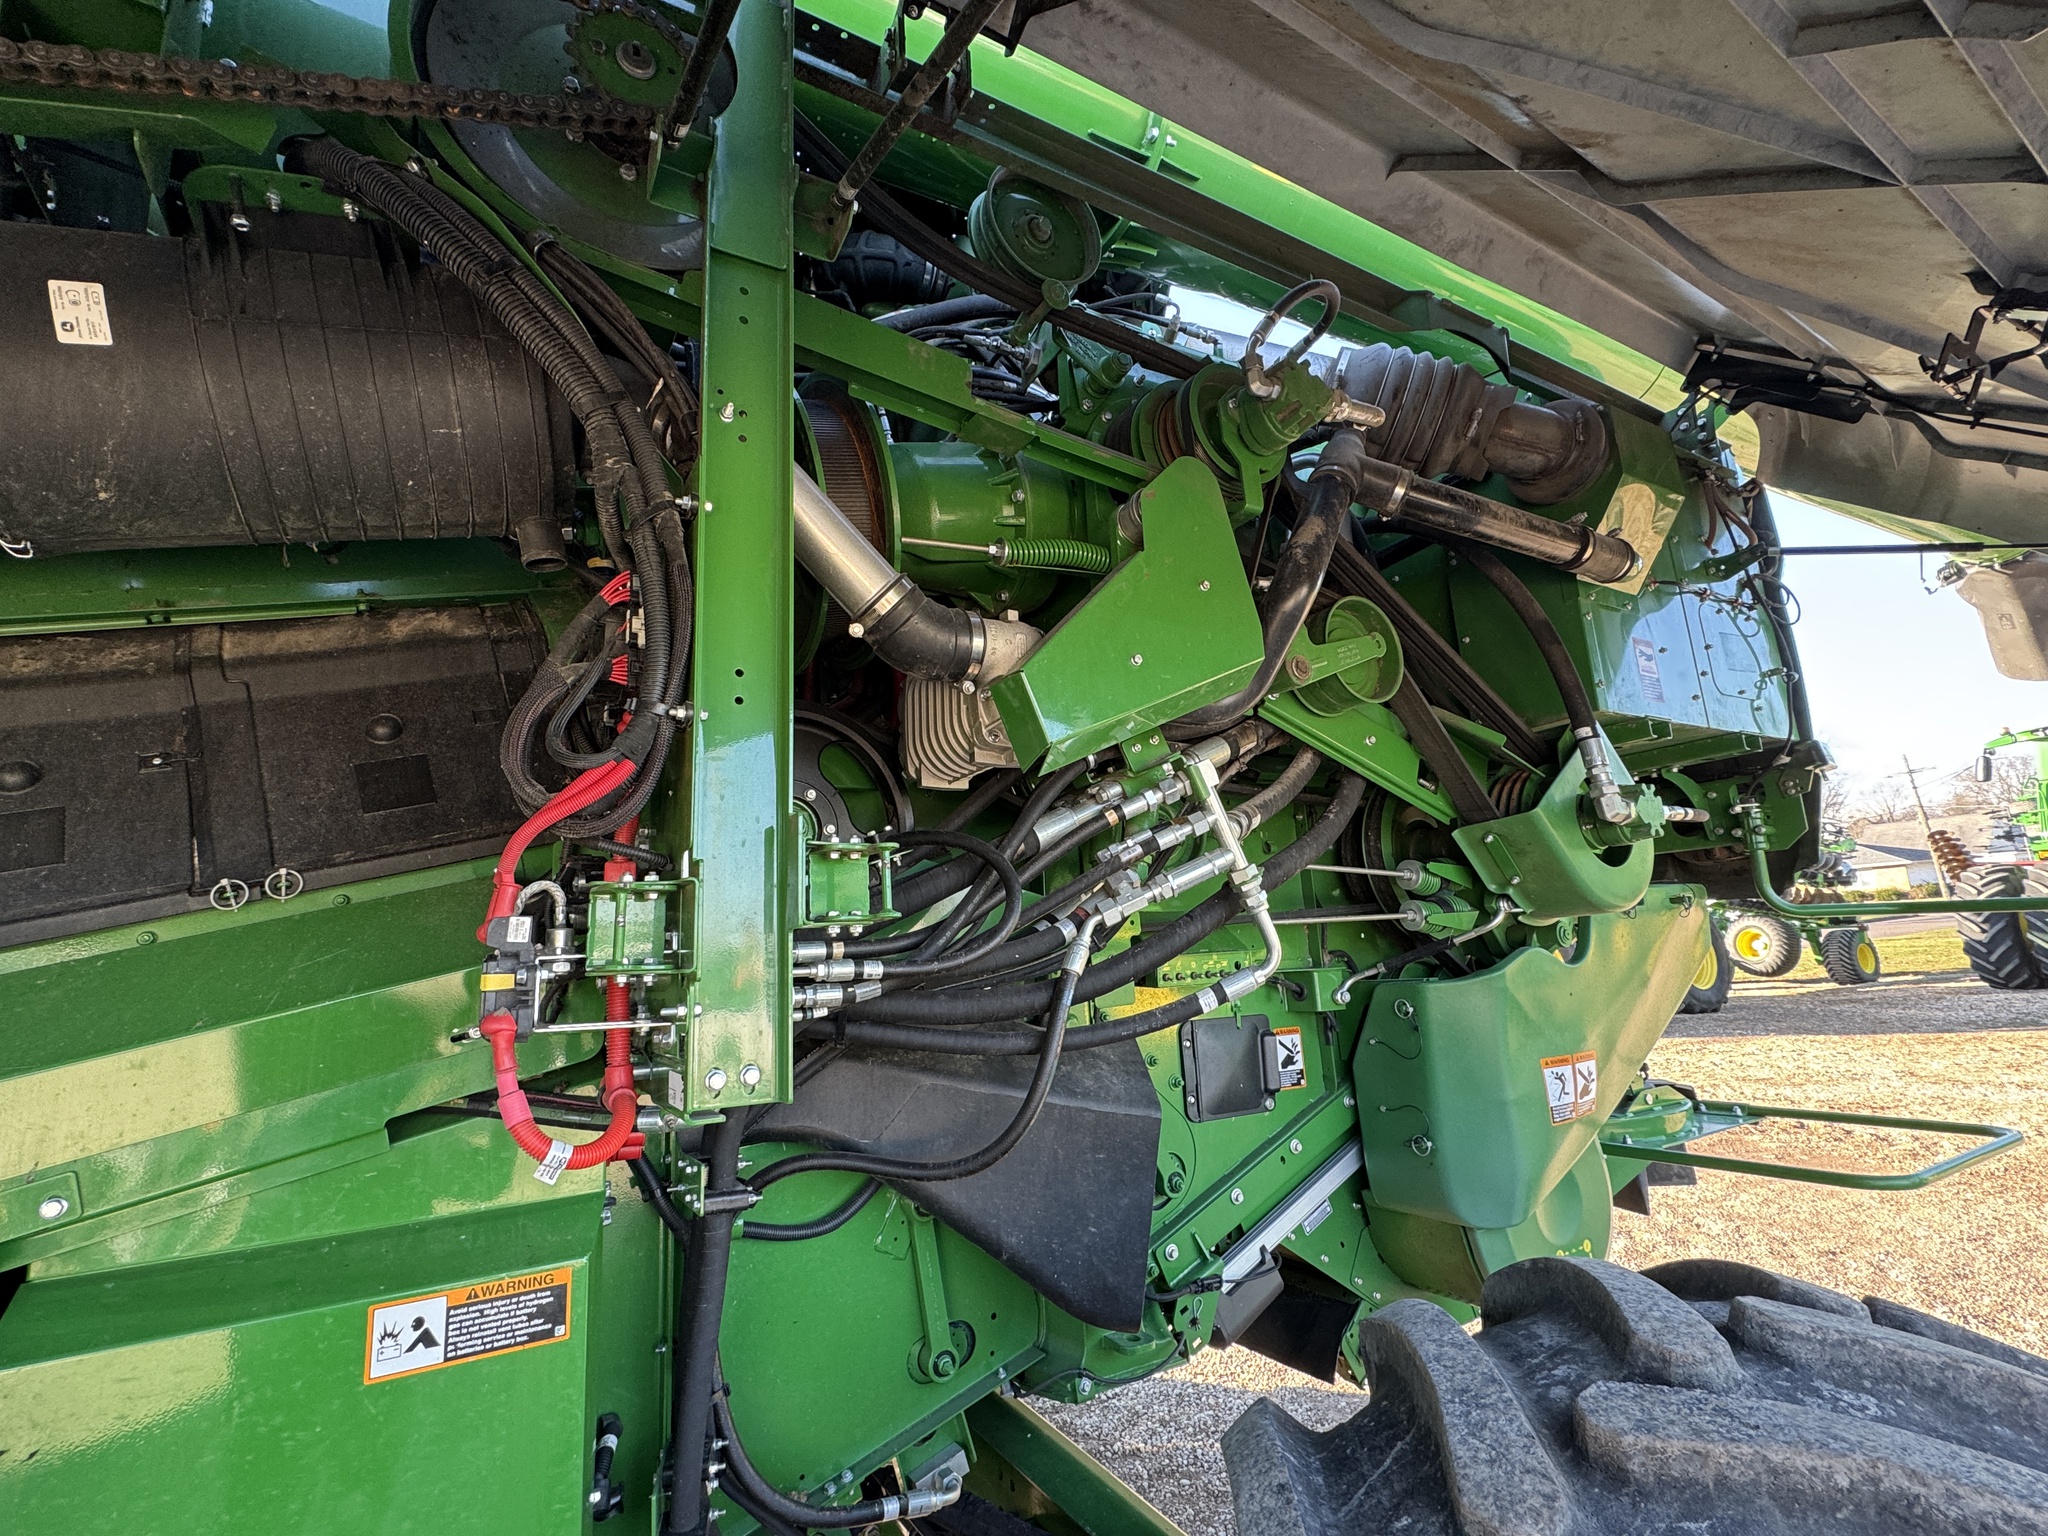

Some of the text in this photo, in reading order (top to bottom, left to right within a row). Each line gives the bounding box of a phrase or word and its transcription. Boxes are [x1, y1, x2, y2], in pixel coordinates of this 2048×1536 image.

[1280, 1027, 1299, 1035] WARNING
[1550, 1057, 1569, 1065] WARNING
[481, 1274, 554, 1297] WARNING
[469, 1302, 491, 1311] serious
[493, 1298, 510, 1306] injury
[526, 1297, 553, 1307] hydrogen
[516, 1307, 537, 1315] battery
[483, 1332, 505, 1342] service
[515, 1324, 552, 1336] maintenance
[448, 1334, 470, 1343] Always
[494, 1337, 514, 1348] battery
